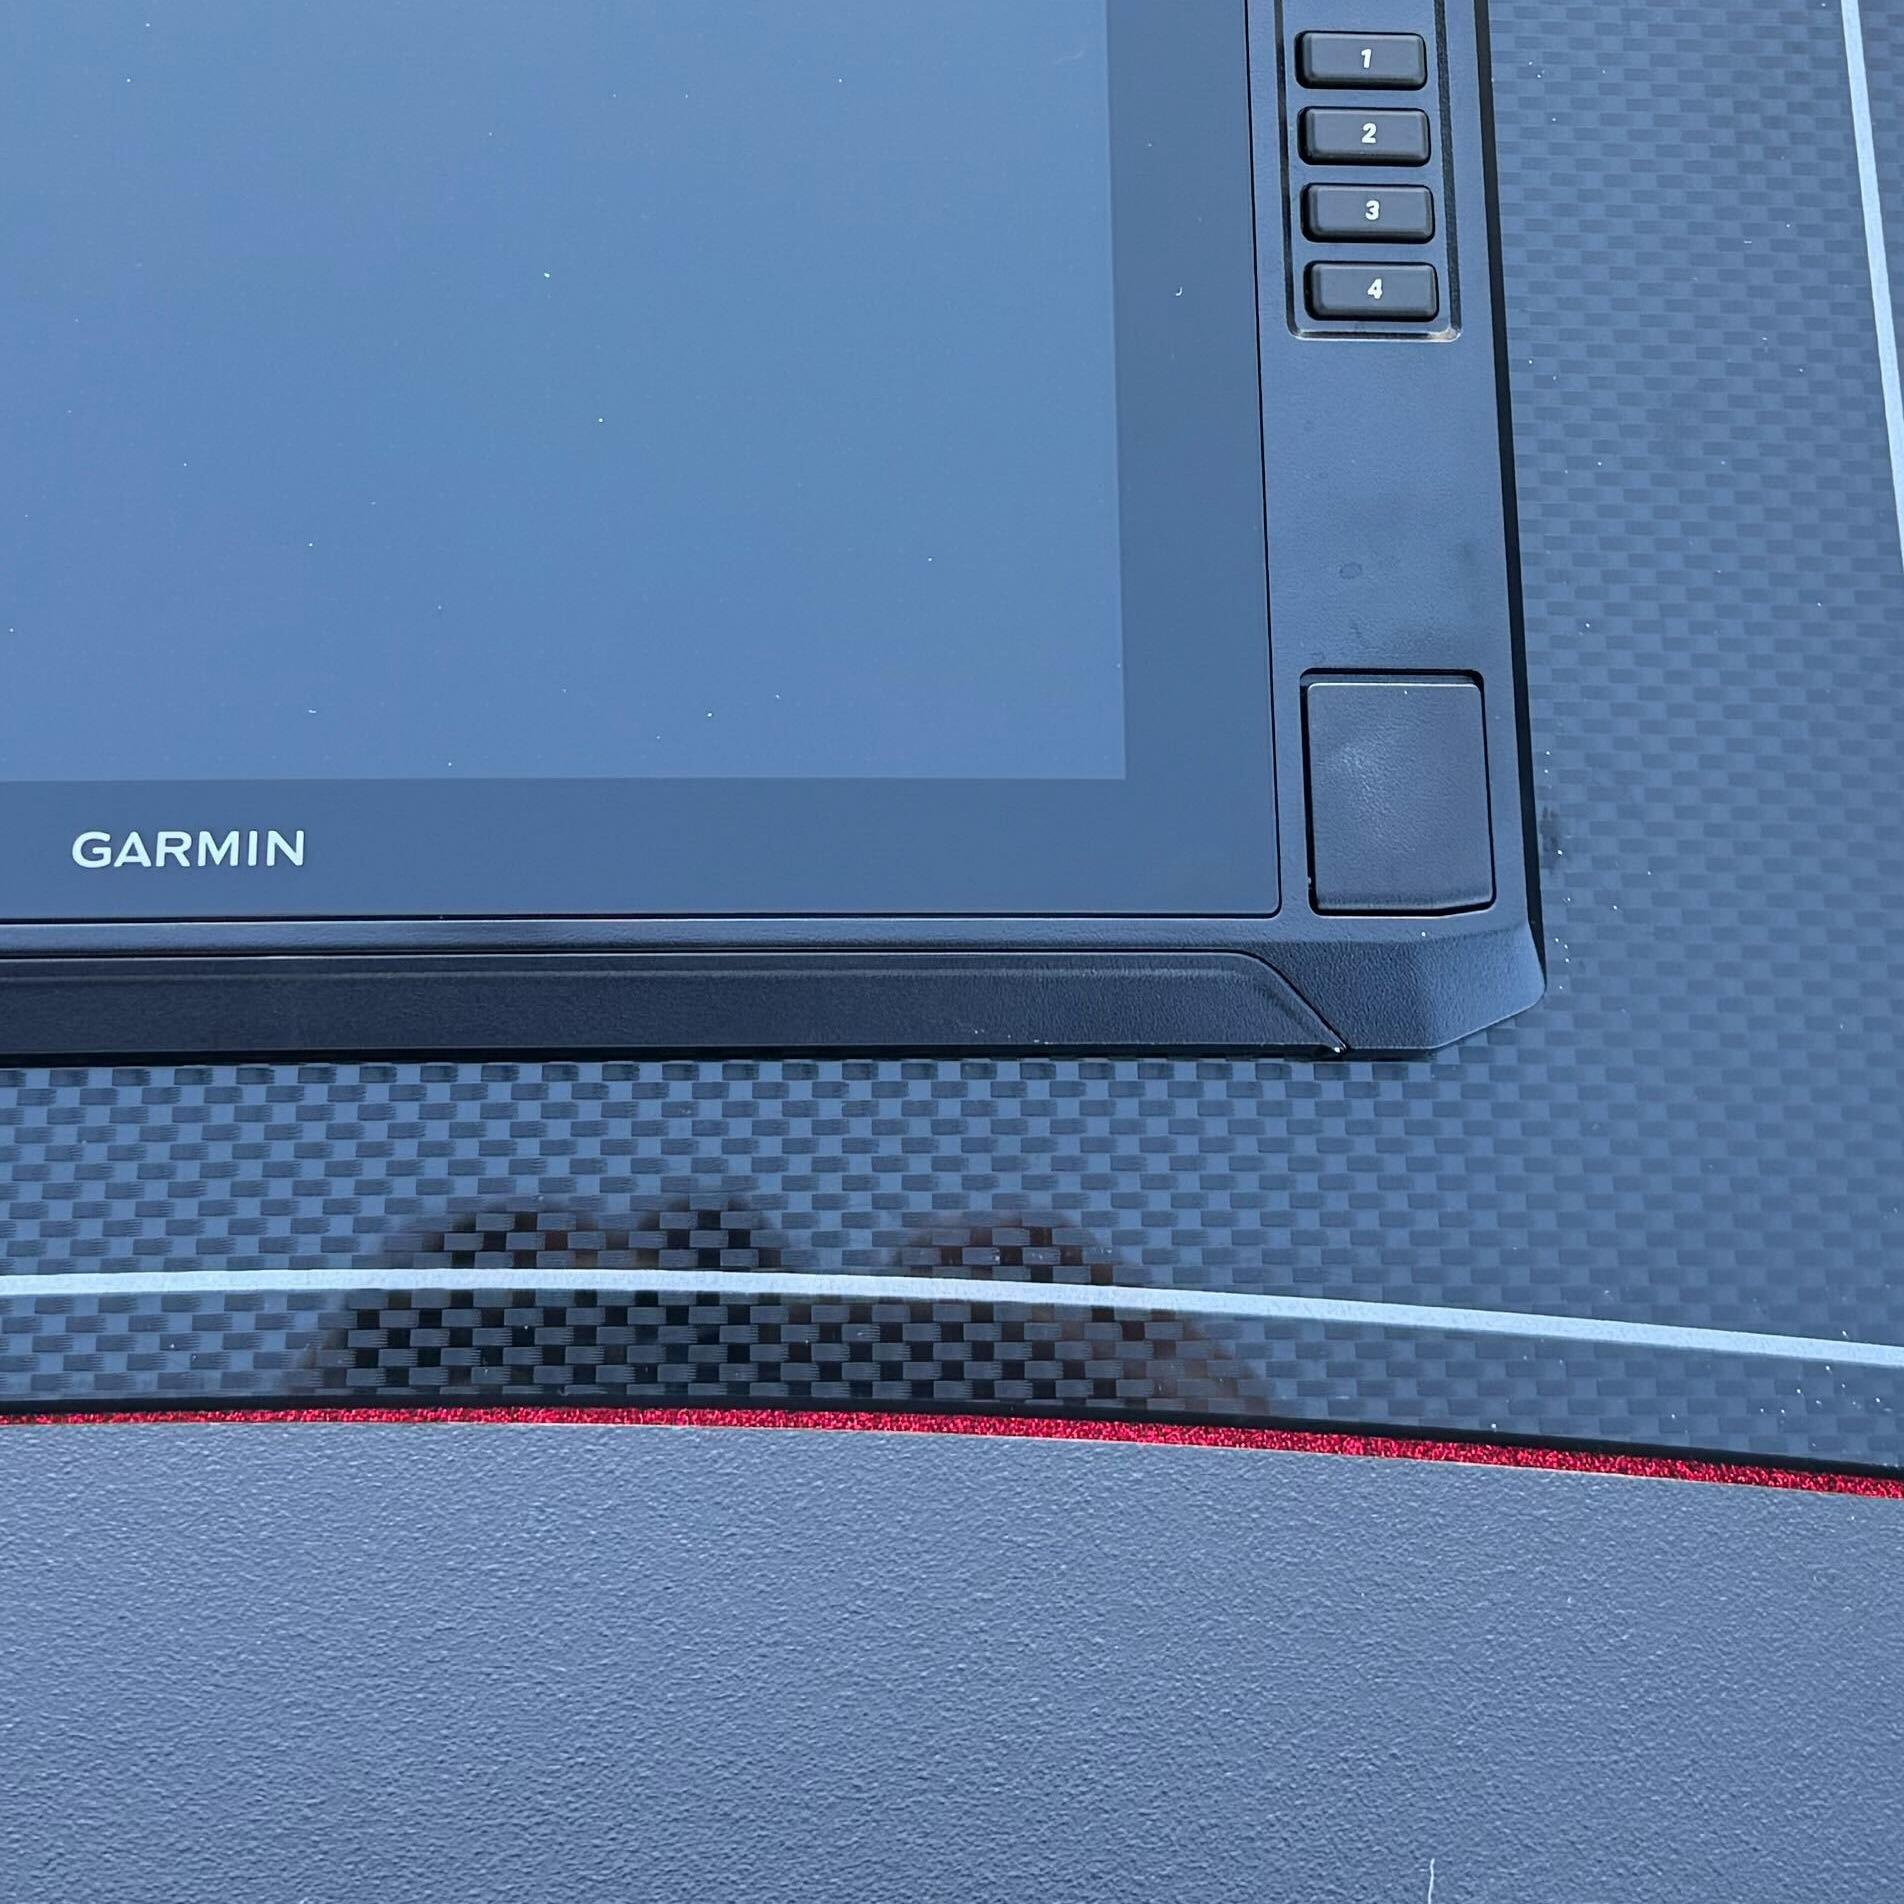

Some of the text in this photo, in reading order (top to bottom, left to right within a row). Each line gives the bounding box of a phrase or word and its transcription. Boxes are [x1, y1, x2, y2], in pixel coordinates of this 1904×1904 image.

[1360, 48, 1372, 70] 1
[1361, 122, 1377, 145] 2
[1364, 200, 1380, 222] 3
[1366, 278, 1383, 300] 4
[72, 830, 305, 868] GARMIN
